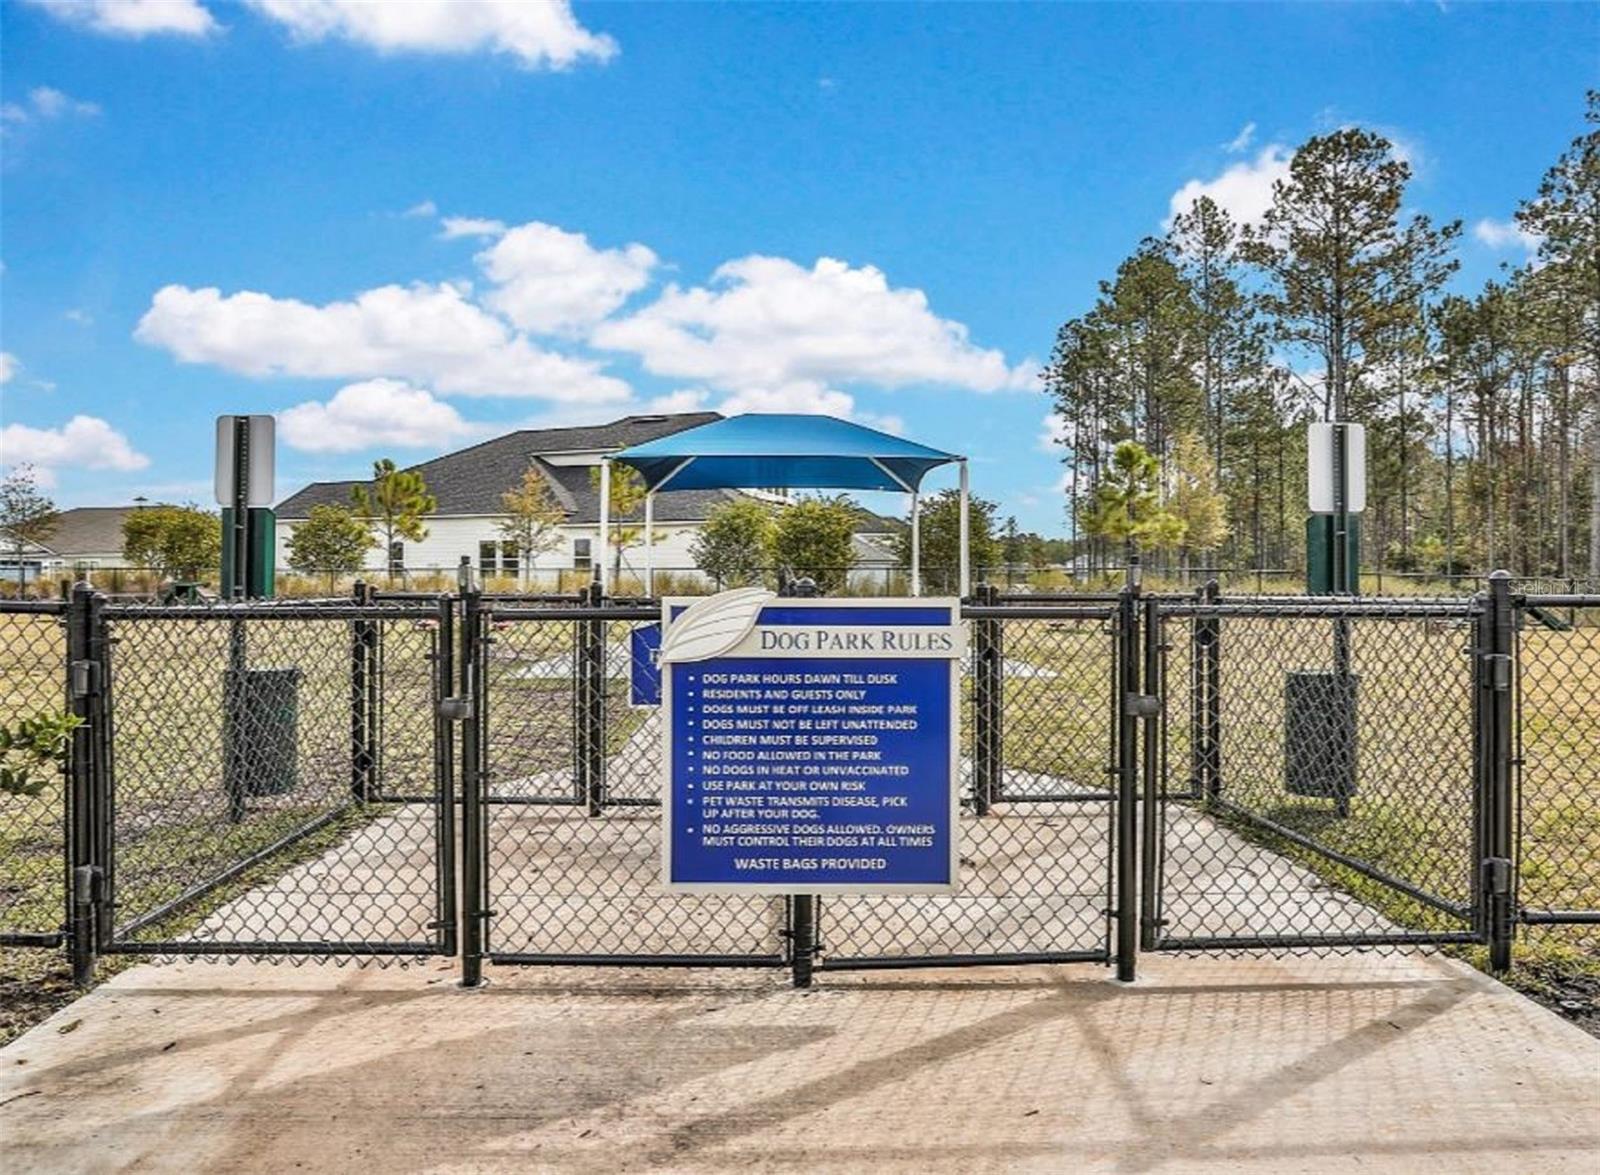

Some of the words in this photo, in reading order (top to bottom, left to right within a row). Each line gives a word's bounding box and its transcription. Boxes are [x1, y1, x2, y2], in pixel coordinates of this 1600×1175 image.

[761, 631, 810, 650] DOG
[817, 631, 875, 650] PARK
[882, 631, 953, 650] RULES
[702, 675, 728, 683] DOG
[730, 675, 761, 683] PARK
[762, 675, 802, 683] HOURS
[804, 675, 841, 683] DAWN
[842, 675, 866, 683] TILL
[867, 675, 897, 683] DUSK
[702, 690, 763, 699] RESIDENTS
[763, 690, 789, 699] AND
[791, 690, 834, 699] GUESTS
[835, 690, 866, 699] ONLY
[702, 720, 735, 729] DOGS
[735, 720, 770, 729] MUST
[772, 720, 796, 729] NOT
[798, 720, 813, 729] BE
[815, 720, 839, 729] LEFT
[841, 720, 918, 729] UNATTENDED
[702, 736, 757, 744] CHILDREN
[759, 736, 793, 744] MUST
[794, 736, 809, 744] BE
[811, 736, 878, 744] SUPERVISED
[702, 766, 721, 774] NO
[722, 766, 755, 774] DOGS
[756, 766, 770, 774] IN
[771, 766, 801, 774] HEAT
[802, 766, 820, 774] OR
[821, 766, 910, 774] UNVACCINATED
[702, 781, 724, 790] USE
[725, 781, 756, 790] PARK
[758, 781, 774, 790] AT
[774, 781, 807, 790] YOUR
[808, 781, 839, 790] OWN
[840, 781, 866, 790] RISK
[702, 797, 724, 806] PET
[724, 797, 764, 806] WASTE
[766, 797, 830, 806] TRANSMITS
[831, 797, 880, 807] DISEASE,
[881, 797, 908, 806] PICK
[702, 810, 720, 818] UP
[720, 810, 756, 818] AFTER
[757, 810, 789, 818] YOUR
[790, 810, 820, 818] DOG.
[702, 825, 721, 834] NO
[722, 825, 791, 834] AGGRESSIVE
[792, 825, 826, 834] DOGS
[826, 825, 885, 834] ALLOWED.
[885, 825, 936, 834] OWNERS
[702, 837, 736, 846] MUST
[737, 837, 790, 846] CONTROL
[791, 837, 826, 846] THEIR
[826, 837, 859, 846] DOGS
[859, 837, 876, 846] AT
[877, 837, 898, 846] ALL
[898, 837, 933, 846] TIMES
[734, 859, 780, 869] WASTE
[782, 859, 819, 869] BAGS
[820, 859, 887, 869] PROVIDED
